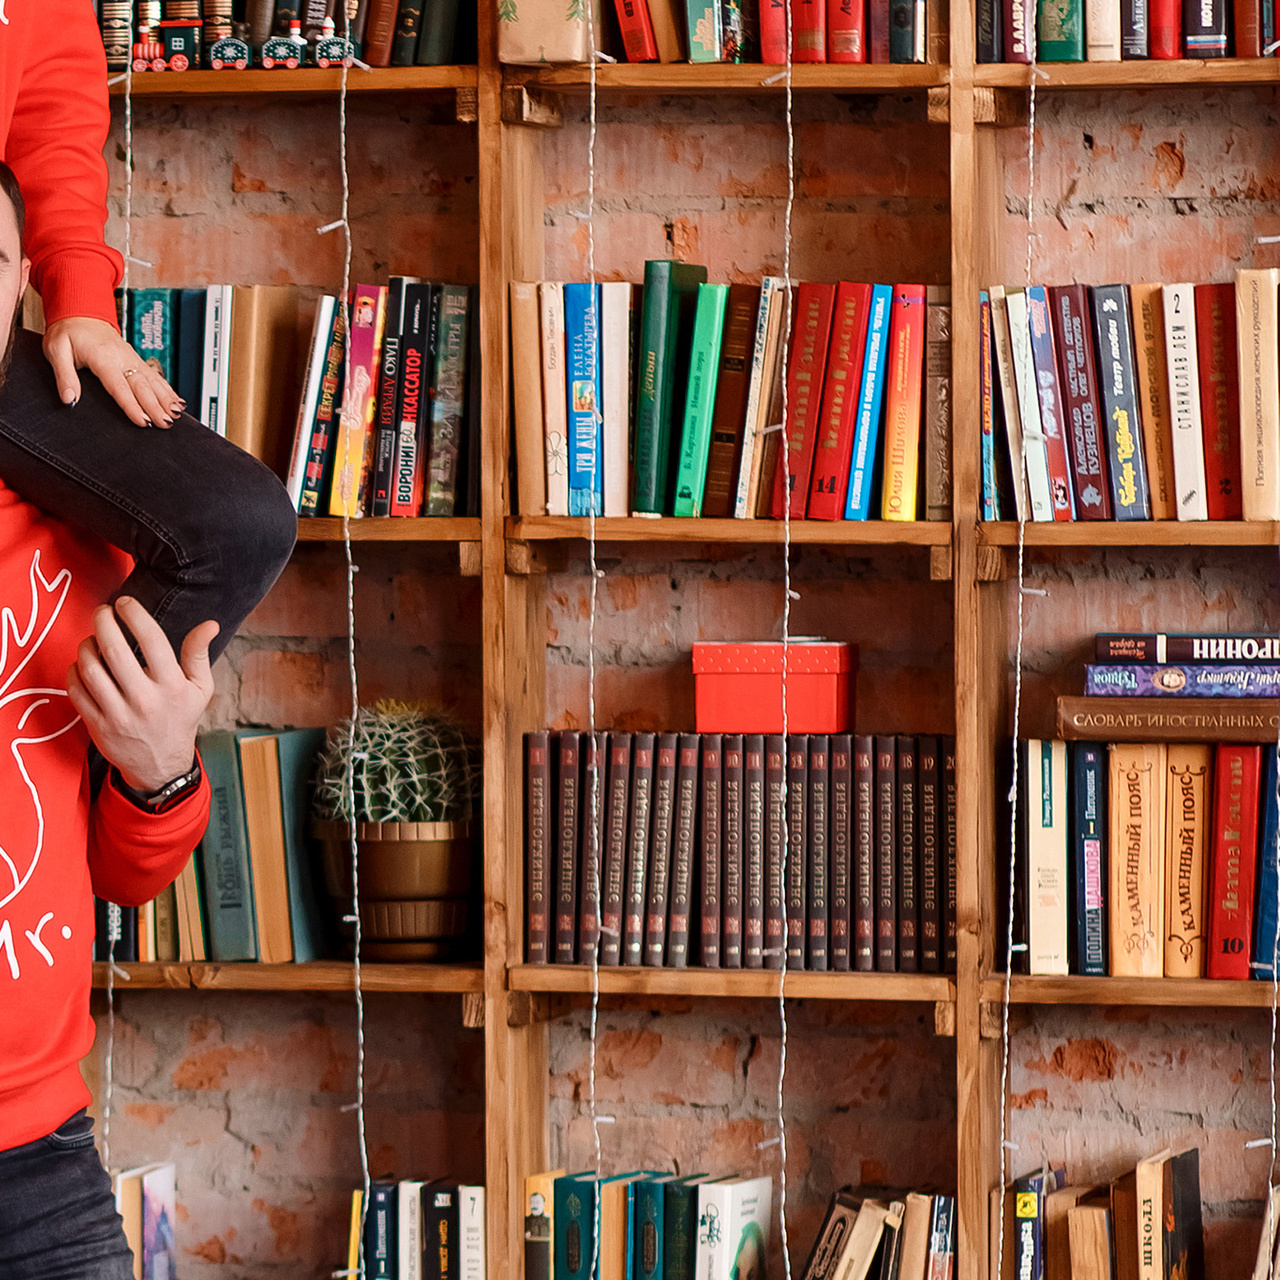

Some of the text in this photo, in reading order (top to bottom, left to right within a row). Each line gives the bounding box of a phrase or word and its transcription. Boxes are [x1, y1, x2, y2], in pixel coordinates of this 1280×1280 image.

[574, 334, 583, 376] ЕЛЕНА
[583, 306, 592, 376] БОГАТЫРЕВА
[1060, 296, 1078, 398] ЧАСТНЫЙ ДЕТЕКТИВ
[1172, 294, 1182, 314] 2
[318, 382, 335, 418] СЕКРЕТ
[382, 338, 398, 424] ПАКО АРРАЙЯ
[401, 348, 422, 422] НКАССАТОР
[641, 350, 656, 400] Деньги
[1107, 319, 1125, 396] Театр любви
[1142, 346, 1162, 418] МОРСКОЙ
[1172, 324, 1192, 430] СТАНИСЛАВ ЛЕМ
[1250, 280, 1266, 486] Полная энциклопедия женских рукоделий
[576, 417, 593, 472] ТРИ ЖЕНЫ
[815, 474, 835, 494] 14
[888, 404, 908, 514] Юлия Шилова
[1081, 402, 1100, 475] КУЗНЕЦОВ
[566, 750, 574, 764] 2
[728, 753, 738, 766] 10
[859, 755, 870, 768] 16
[881, 755, 892, 768] 17
[902, 756, 912, 768] 18
[924, 757, 934, 770] 19
[1073, 714, 1144, 726] СЛОВАРЬ
[1148, 714, 1264, 727] ИНОСТРАННЫХ
[532, 777, 544, 904] ЭНЦИКЛОПЕДИЯ
[561, 778, 574, 904] ЭНЦИКЛОПЕДИЯ
[608, 778, 624, 904] ЭНЦИКЛОПЕДИЯ
[630, 778, 648, 904] ЭНЦИКЛОПЕДИЯ
[652, 778, 670, 904] ЭНЦИКЛОПЕДИЯ
[676, 779, 693, 905] ЭНЦИКЛОПЕДИЯ
[706, 780, 717, 906] ЭНЦИКЛОПЕДИЯ
[727, 781, 738, 906] ЭНЦИКЛОПЕДИЯ
[750, 782, 761, 908] ЭНЦИКЛОПЕДИЯ
[770, 782, 780, 908] ЭНЦИКЛОПЕДИЯ
[790, 782, 802, 908] ЭНЦИКЛОПЕДИЯ
[814, 782, 824, 908] ЭНЦИКЛОПЕДИЯ
[836, 782, 846, 908] ЭНЦИКЛОПЕДИЯ
[859, 782, 870, 908] ЭНЦИКЛОПЕДИЯ
[881, 782, 892, 908] ЭНЦИКЛОПЕДИЯ
[902, 783, 914, 909] ЭНЦИКЛОПЕДИЯ
[924, 784, 934, 910] ЭНЦИКЛОПЕДИЯ
[1084, 770, 1102, 963] ПОЛИНА ДАШКОВА Питомник
[1125, 772, 1142, 928] КАМЕННЫЙ ПОЯС
[1178, 774, 1196, 932] КАМЕННЫЙ ПОЯС
[1222, 937, 1244, 954] 10
[439, 1220, 448, 1245] ОДИН
[439, 1246, 448, 1272] ДОМА
[1142, 1198, 1152, 1266] ШКОЛА
